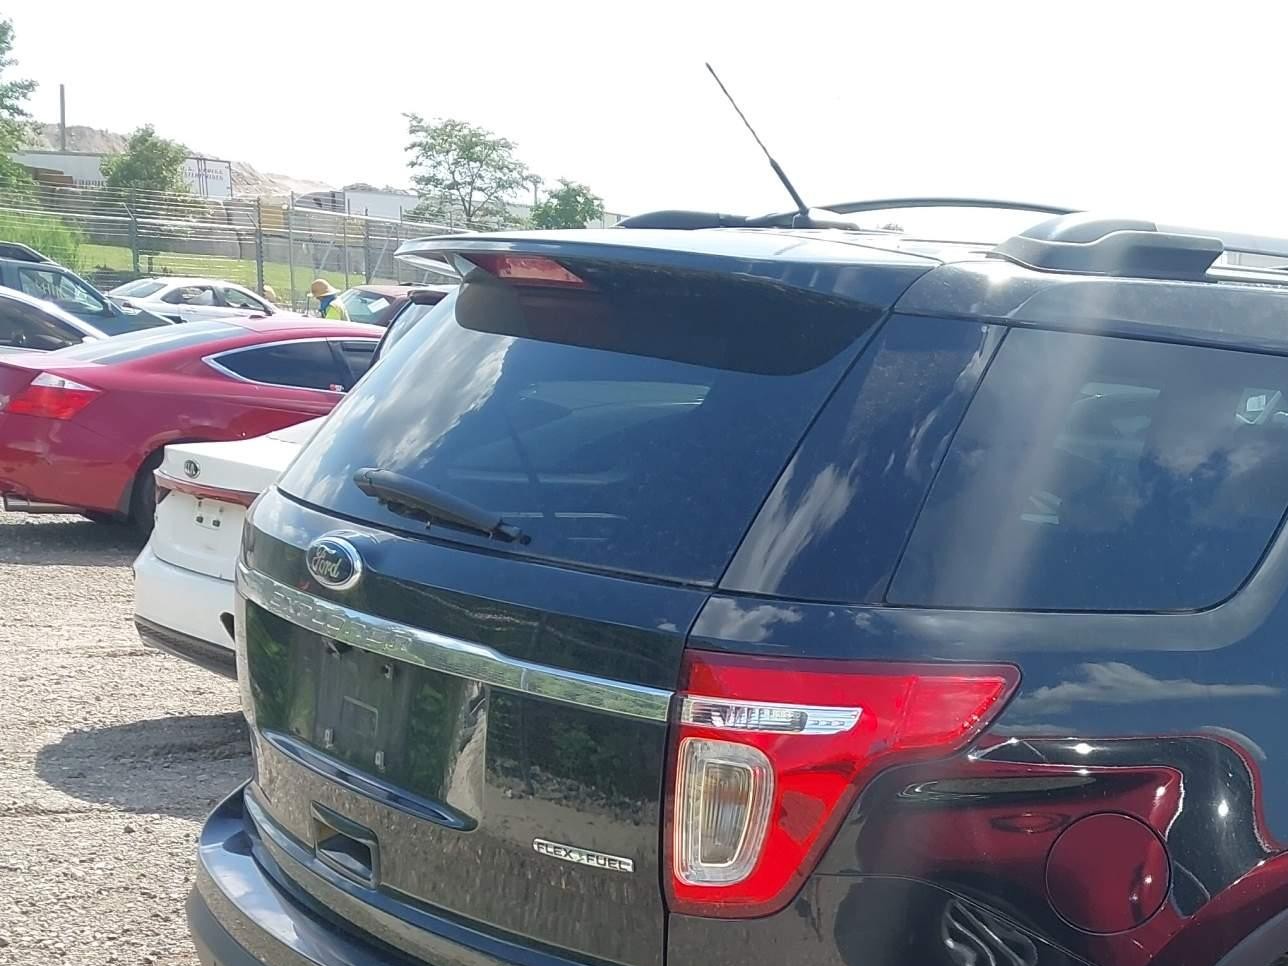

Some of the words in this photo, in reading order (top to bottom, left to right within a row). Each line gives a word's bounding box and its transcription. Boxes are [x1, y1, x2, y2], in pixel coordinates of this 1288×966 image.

[311, 544, 343, 579] Ford
[270, 590, 413, 653] EXPLORER
[536, 841, 574, 860] FLEX
[586, 853, 630, 873] FUEL
